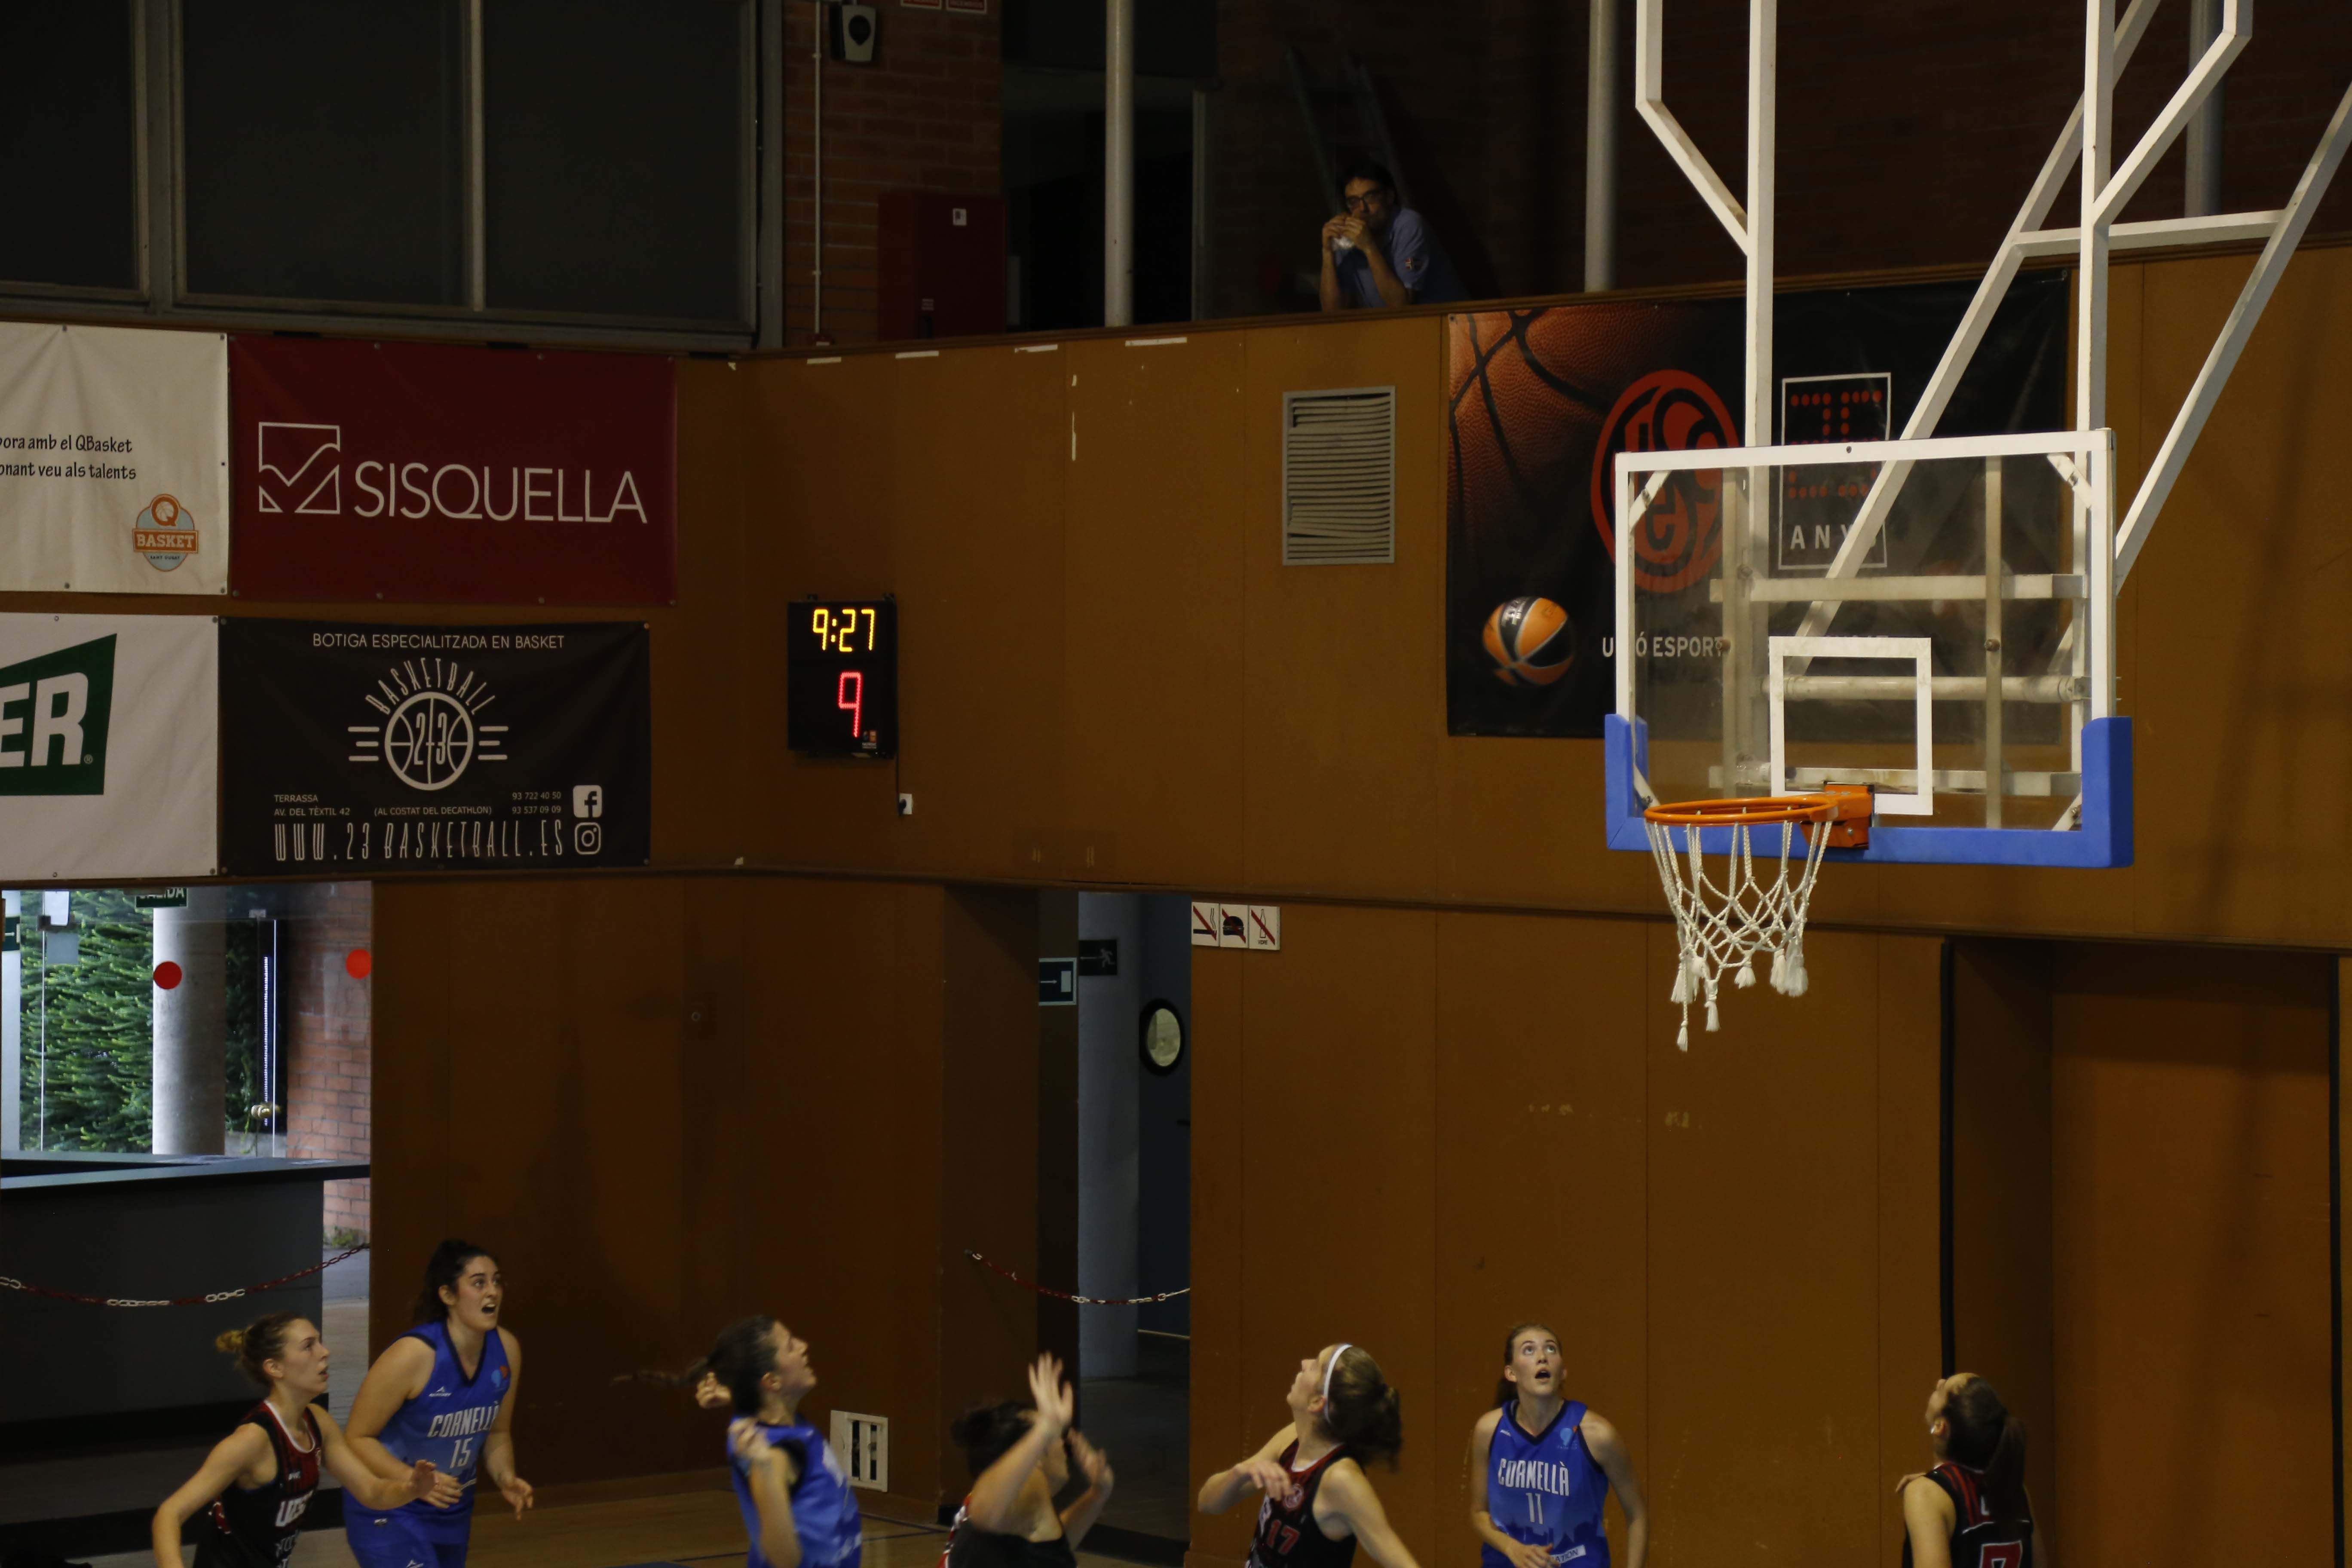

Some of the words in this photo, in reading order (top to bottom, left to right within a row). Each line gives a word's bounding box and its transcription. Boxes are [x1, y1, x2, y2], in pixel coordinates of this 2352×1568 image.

[28, 434, 57, 450] amb
[61, 435, 72, 450] el
[76, 435, 133, 453] QBasket
[39, 465, 61, 477] veu
[65, 462, 86, 478] als
[89, 463, 136, 479] talents
[353, 460, 648, 524] SISQUELLA
[151, 496, 179, 527] Q
[136, 533, 194, 548] BASKET
[313, 633, 367, 647] BOTIGA
[372, 634, 487, 649] ESPECIALITZADA
[492, 635, 509, 648] EN
[516, 635, 564, 649] BASKET
[812, 608, 876, 652] 9:27
[1602, 631, 1647, 658] UÓ
[365, 657, 495, 716] BASKETBALL
[838, 671, 863, 738] 9
[413, 712, 447, 765] 23
[274, 794, 318, 803] TERRASSA
[511, 792, 522, 800] 93
[524, 792, 538, 800] 722
[552, 791, 561, 799] 50
[511, 806, 522, 814] 93
[524, 805, 537, 814] 537
[540, 805, 549, 814] 09
[551, 805, 561, 814] 09
[274, 808, 286, 816] AV.
[289, 808, 306, 816] DEL
[309, 805, 337, 816] TÈXTIL
[339, 808, 351, 816] 42
[374, 807, 387, 817] (AL
[389, 807, 420, 816] COSTAT
[423, 807, 438, 815] DEL
[441, 805, 492, 815] DECATHLON)
[449, 1437, 473, 1469] 15
[1498, 1458, 1570, 1497] CORNELLÀ
[1525, 1492, 1544, 1525] 11
[1267, 1519, 1301, 1555] 17
